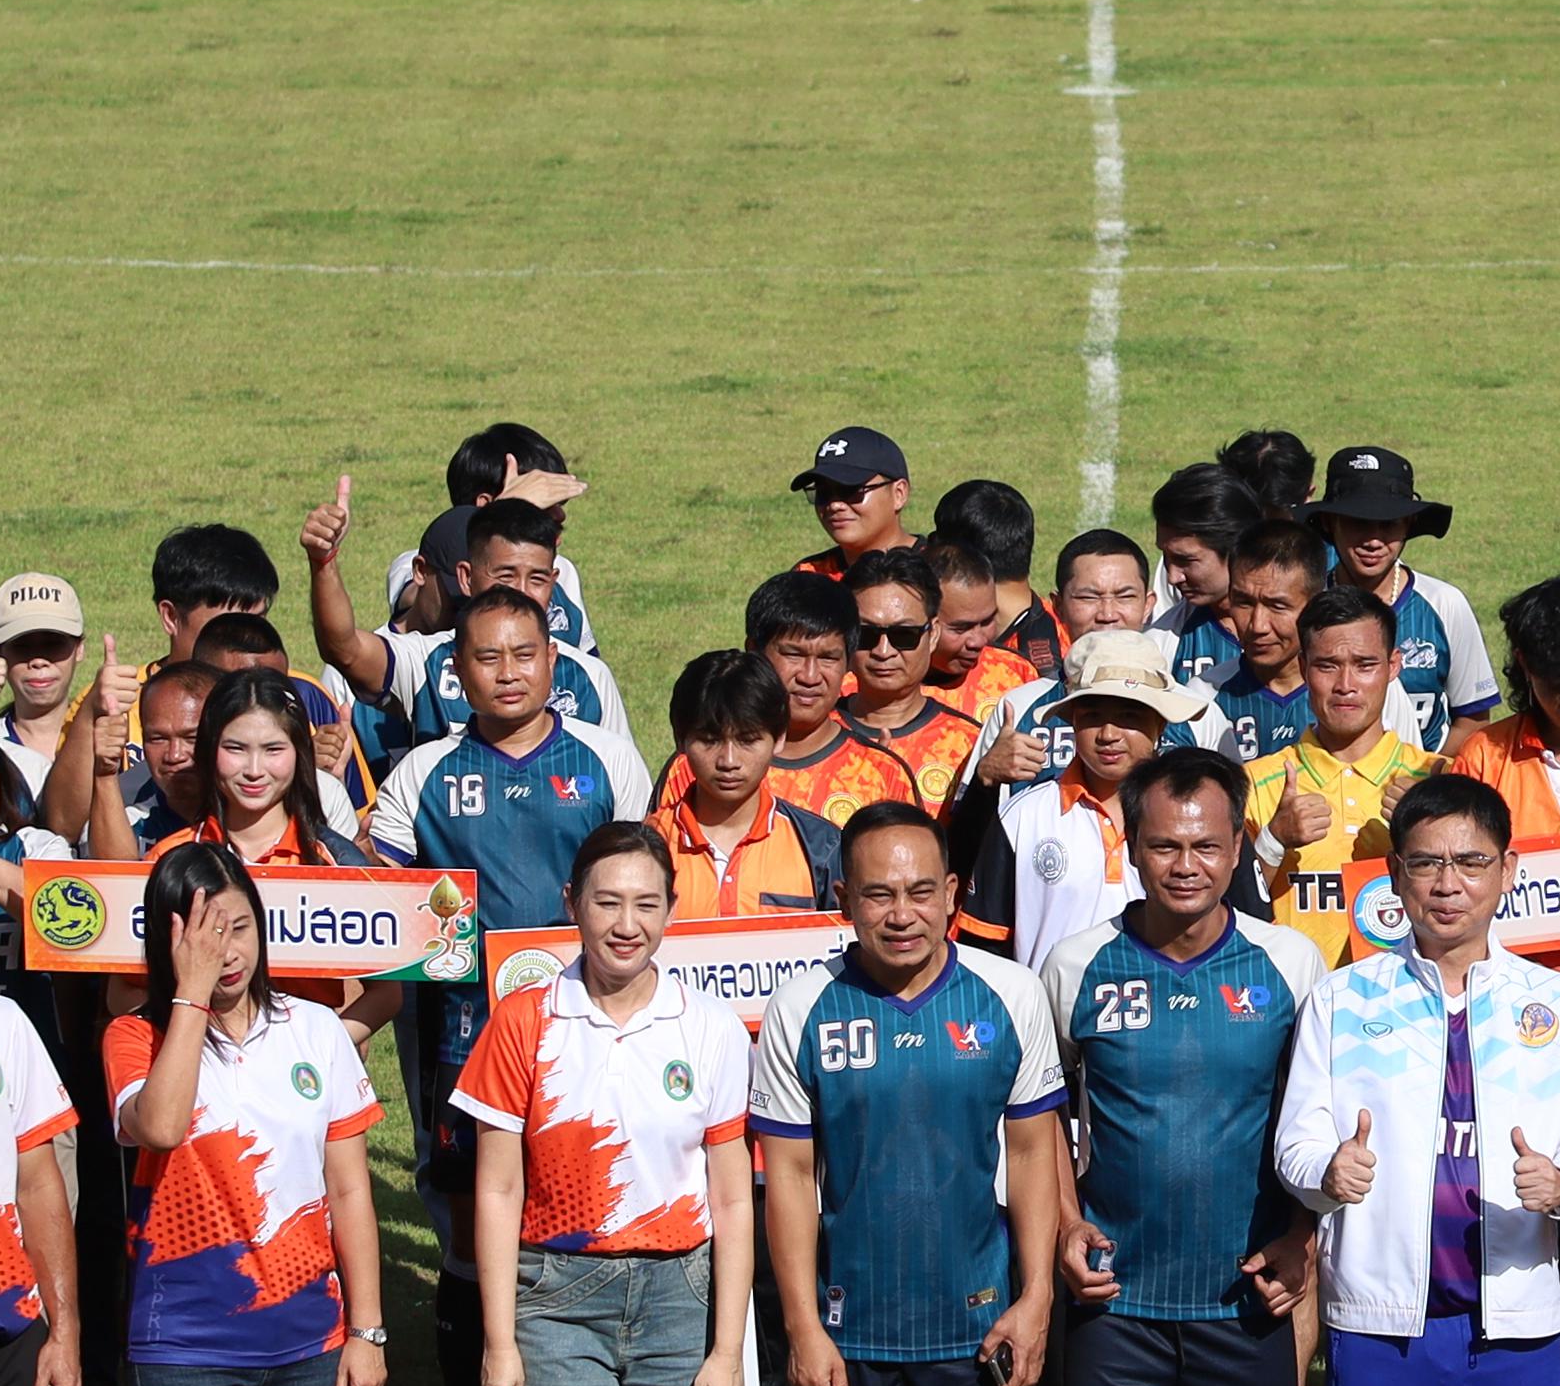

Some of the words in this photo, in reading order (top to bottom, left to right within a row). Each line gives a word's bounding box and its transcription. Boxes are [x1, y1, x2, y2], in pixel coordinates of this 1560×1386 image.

[9, 585, 62, 607] PILOT
[442, 773, 487, 819] 18
[1288, 871, 1346, 912] TA
[1094, 979, 1152, 1033] 23
[817, 1017, 878, 1073] 50
